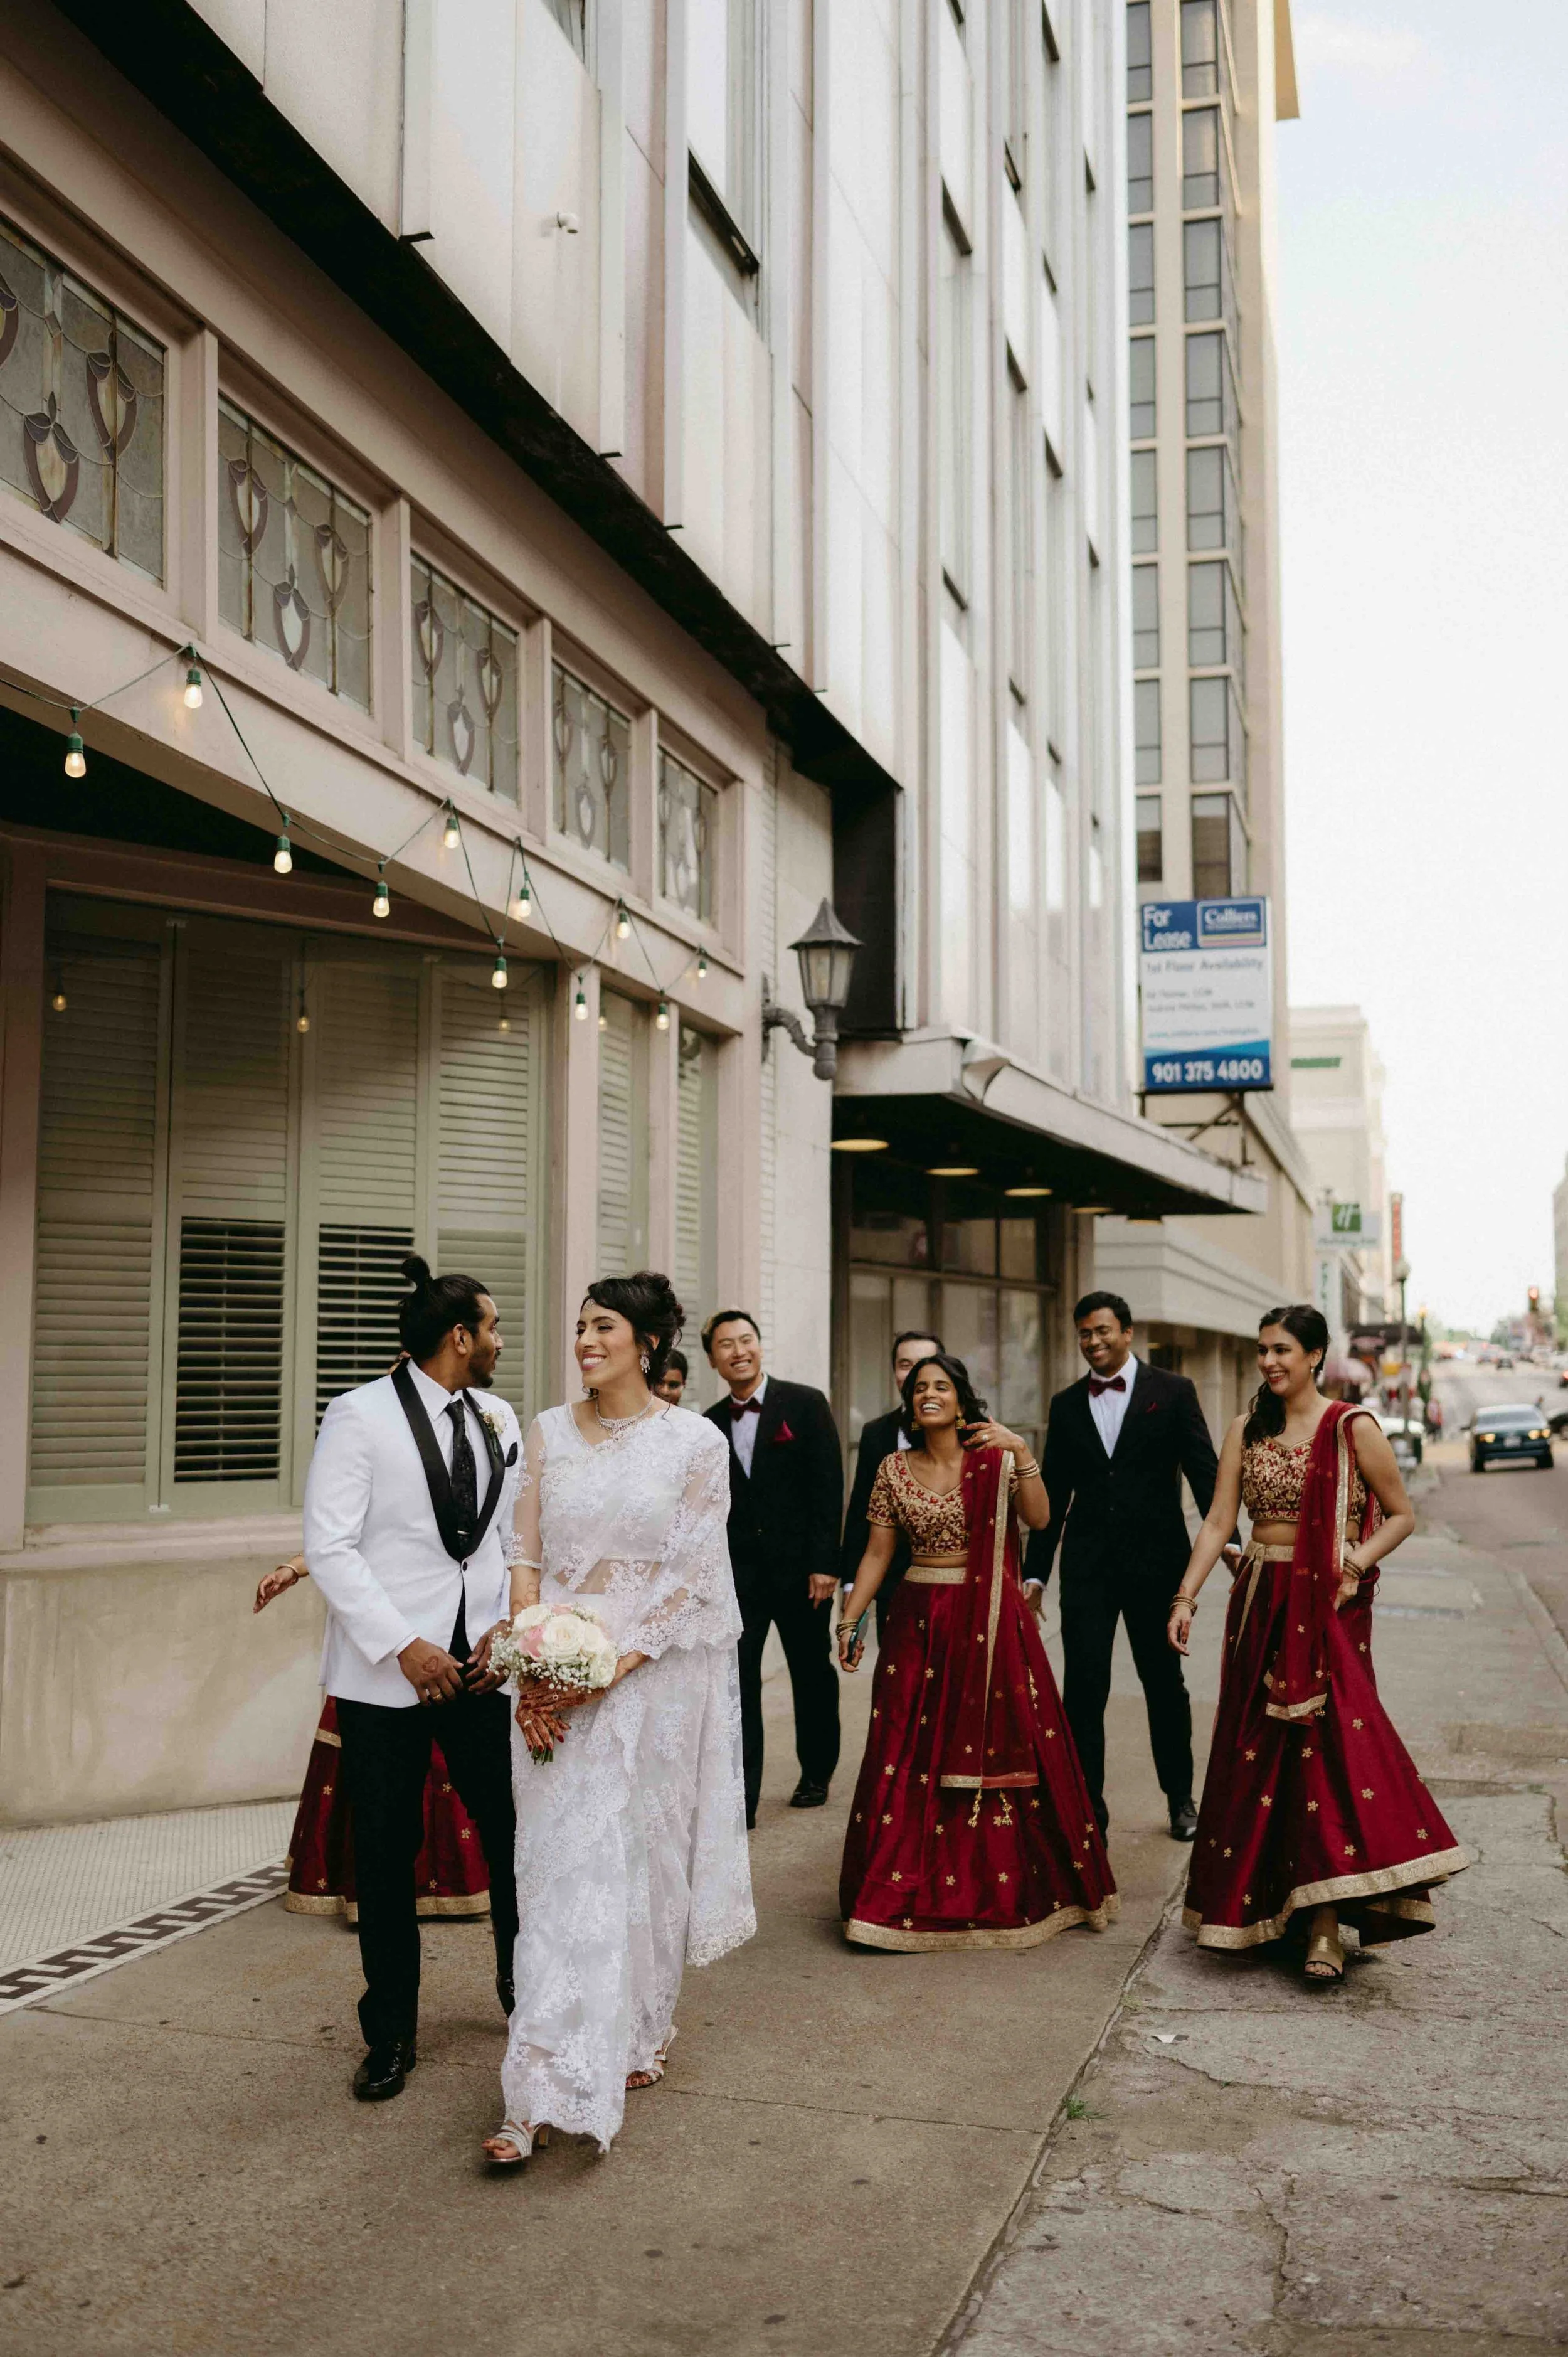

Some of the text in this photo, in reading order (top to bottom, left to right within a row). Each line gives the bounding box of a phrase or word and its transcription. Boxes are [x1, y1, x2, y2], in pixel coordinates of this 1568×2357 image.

[1143, 905, 1172, 927] For
[1205, 908, 1258, 925] Colliers
[1144, 929, 1192, 950] Lease
[1200, 957, 1263, 972] Availability
[1152, 1058, 1264, 1084] 901 375 4800
